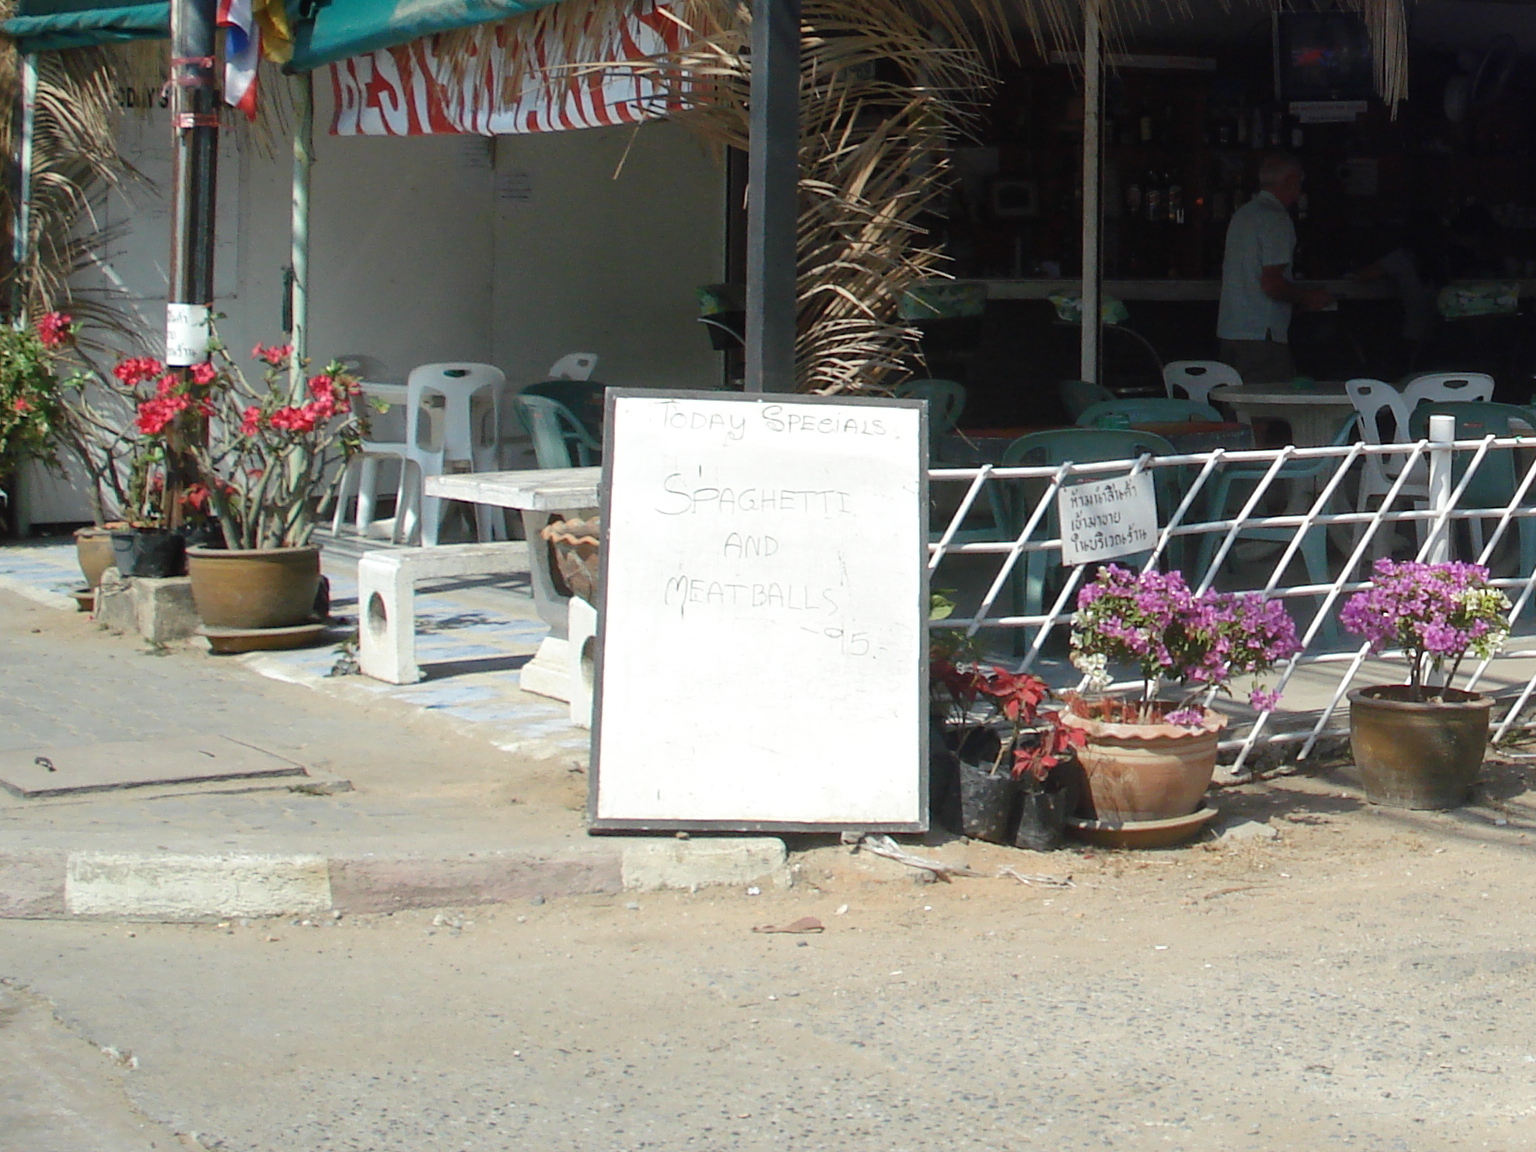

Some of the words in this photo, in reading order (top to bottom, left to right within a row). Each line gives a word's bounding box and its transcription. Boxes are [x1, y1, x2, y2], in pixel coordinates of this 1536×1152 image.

[655, 472, 850, 516] SPAGHETTI
[724, 532, 779, 559] AND
[665, 575, 839, 618] MEATBALLS
